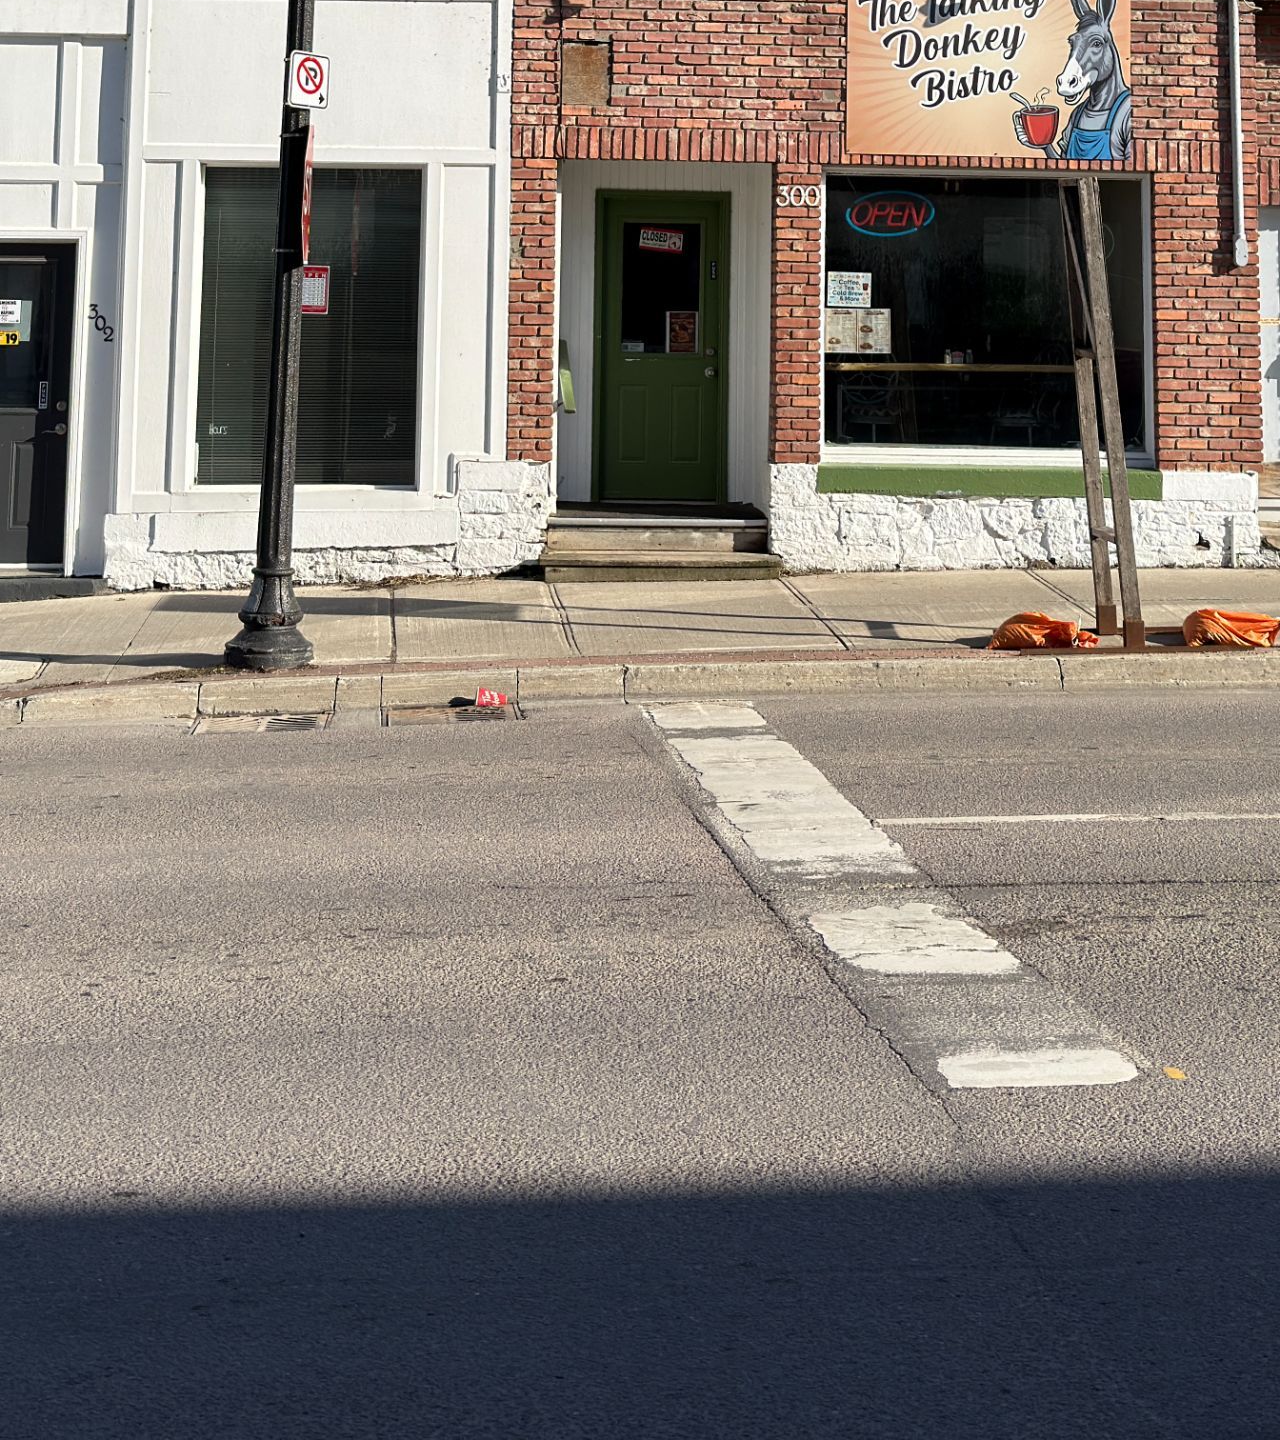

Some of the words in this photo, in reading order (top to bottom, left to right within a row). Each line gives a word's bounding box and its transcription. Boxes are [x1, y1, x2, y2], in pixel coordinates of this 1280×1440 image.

[882, 23, 1026, 69] Donkey
[911, 66, 1019, 108] Bistro
[776, 185, 820, 206] 300
[851, 201, 926, 227] OPEN
[641, 230, 668, 243] CLOSED
[88, 303, 114, 342] 302
[5, 333, 18, 344] 19
